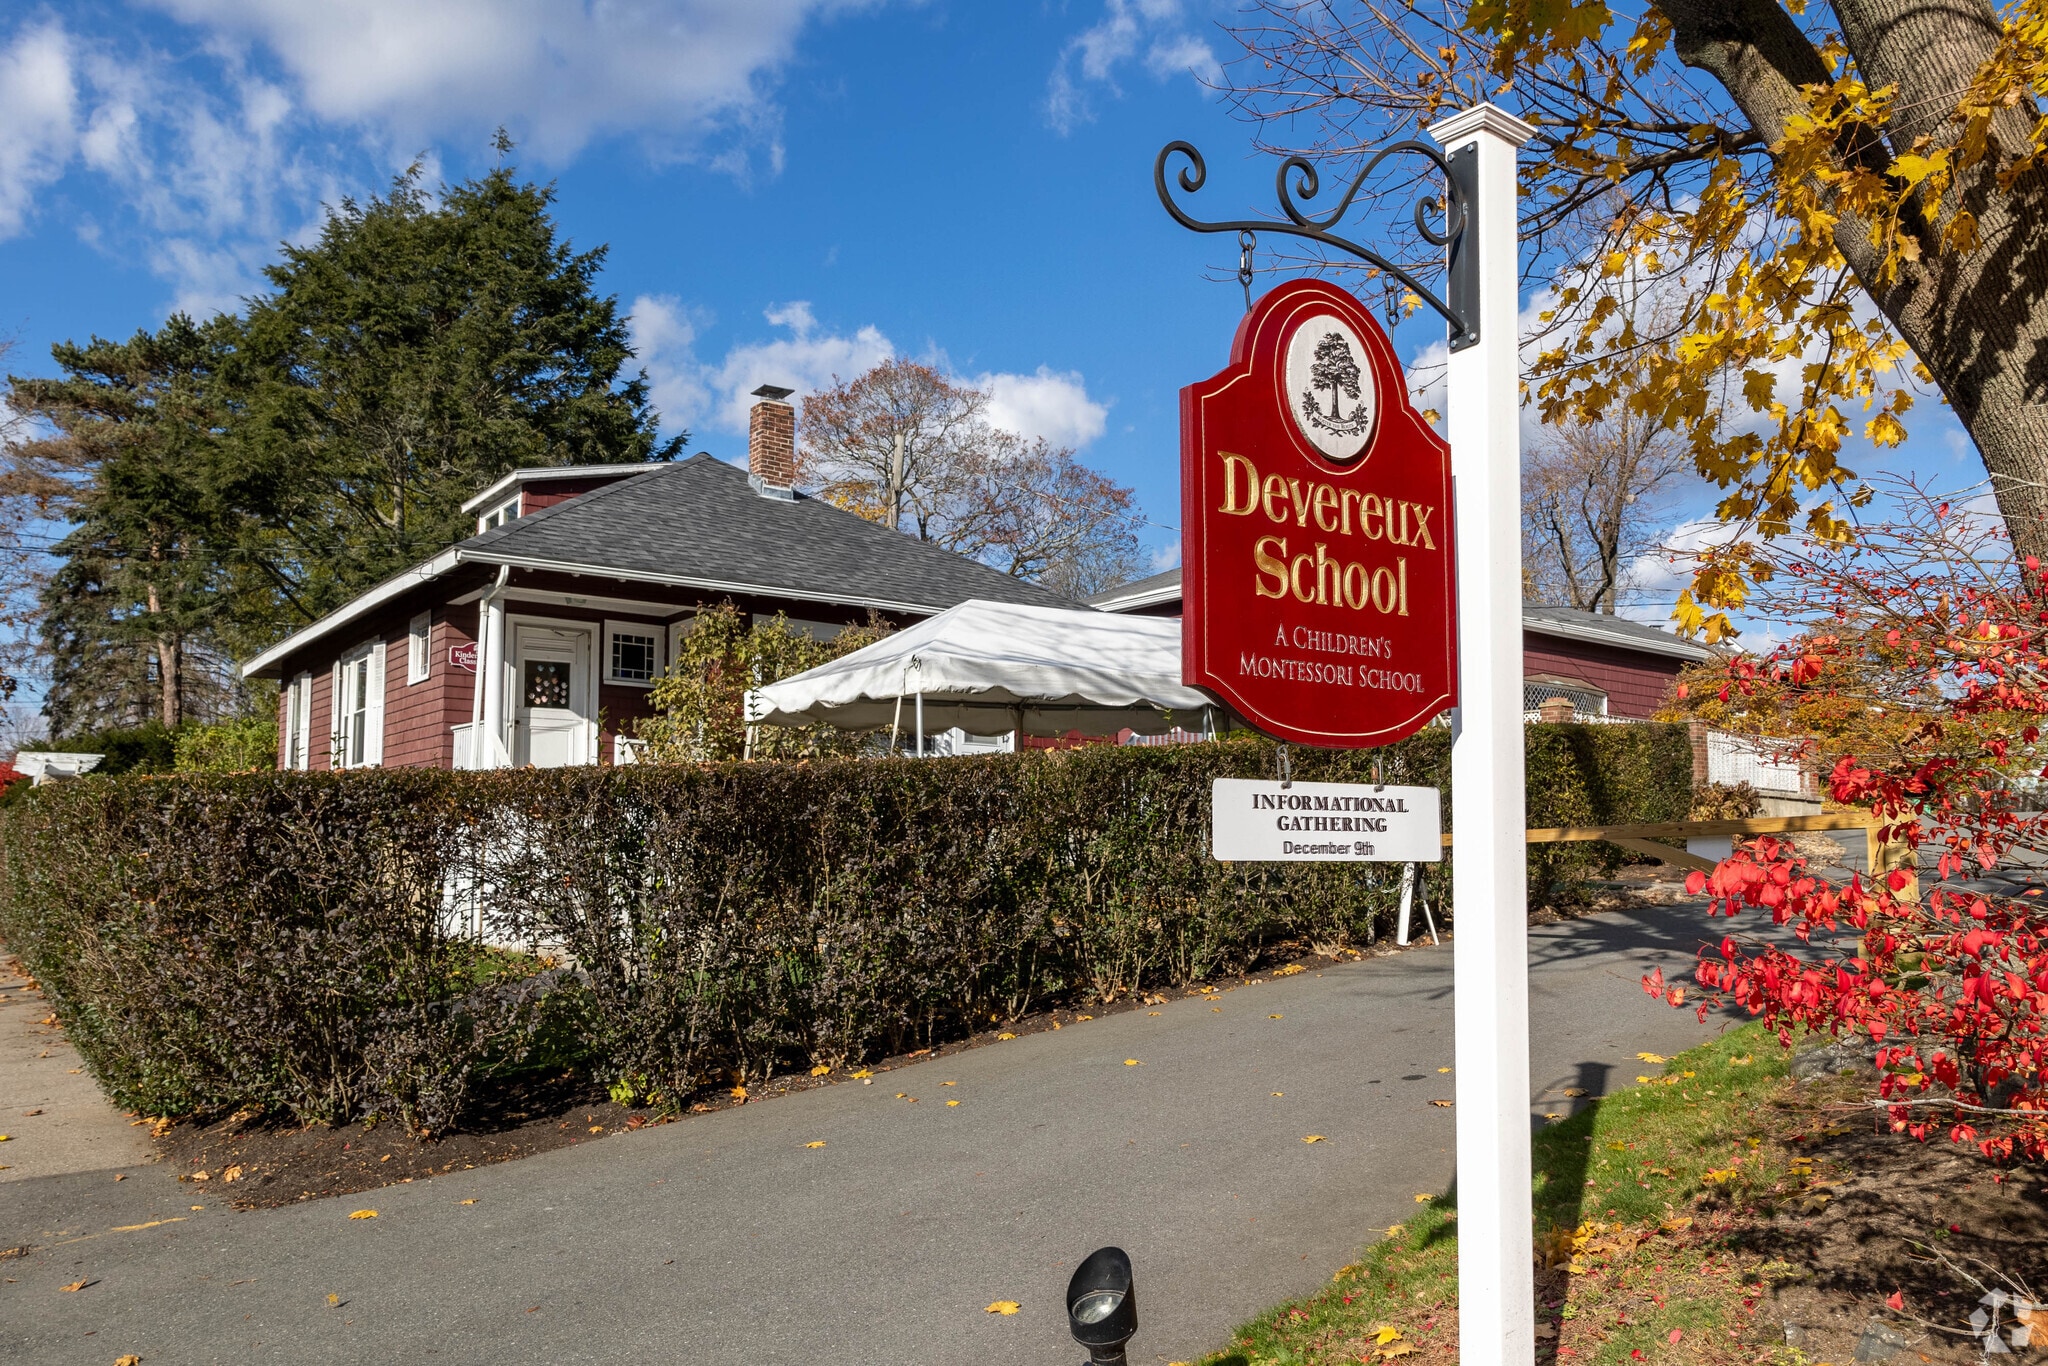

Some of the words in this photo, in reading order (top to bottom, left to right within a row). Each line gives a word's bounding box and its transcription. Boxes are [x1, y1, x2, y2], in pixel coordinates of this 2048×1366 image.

[1217, 450, 1436, 550] Devereux
[1254, 535, 1409, 617] School
[1274, 623, 1289, 647] A
[1293, 625, 1392, 659] CHILDREN'S
[1239, 651, 1353, 686] MONTESSORI
[1359, 664, 1425, 693] SCHOOL
[1252, 794, 1409, 813] INFORMATIONAL
[1277, 815, 1388, 833] GATHERING
[1283, 840, 1351, 855] December
[1353, 841, 1376, 856] 9th
